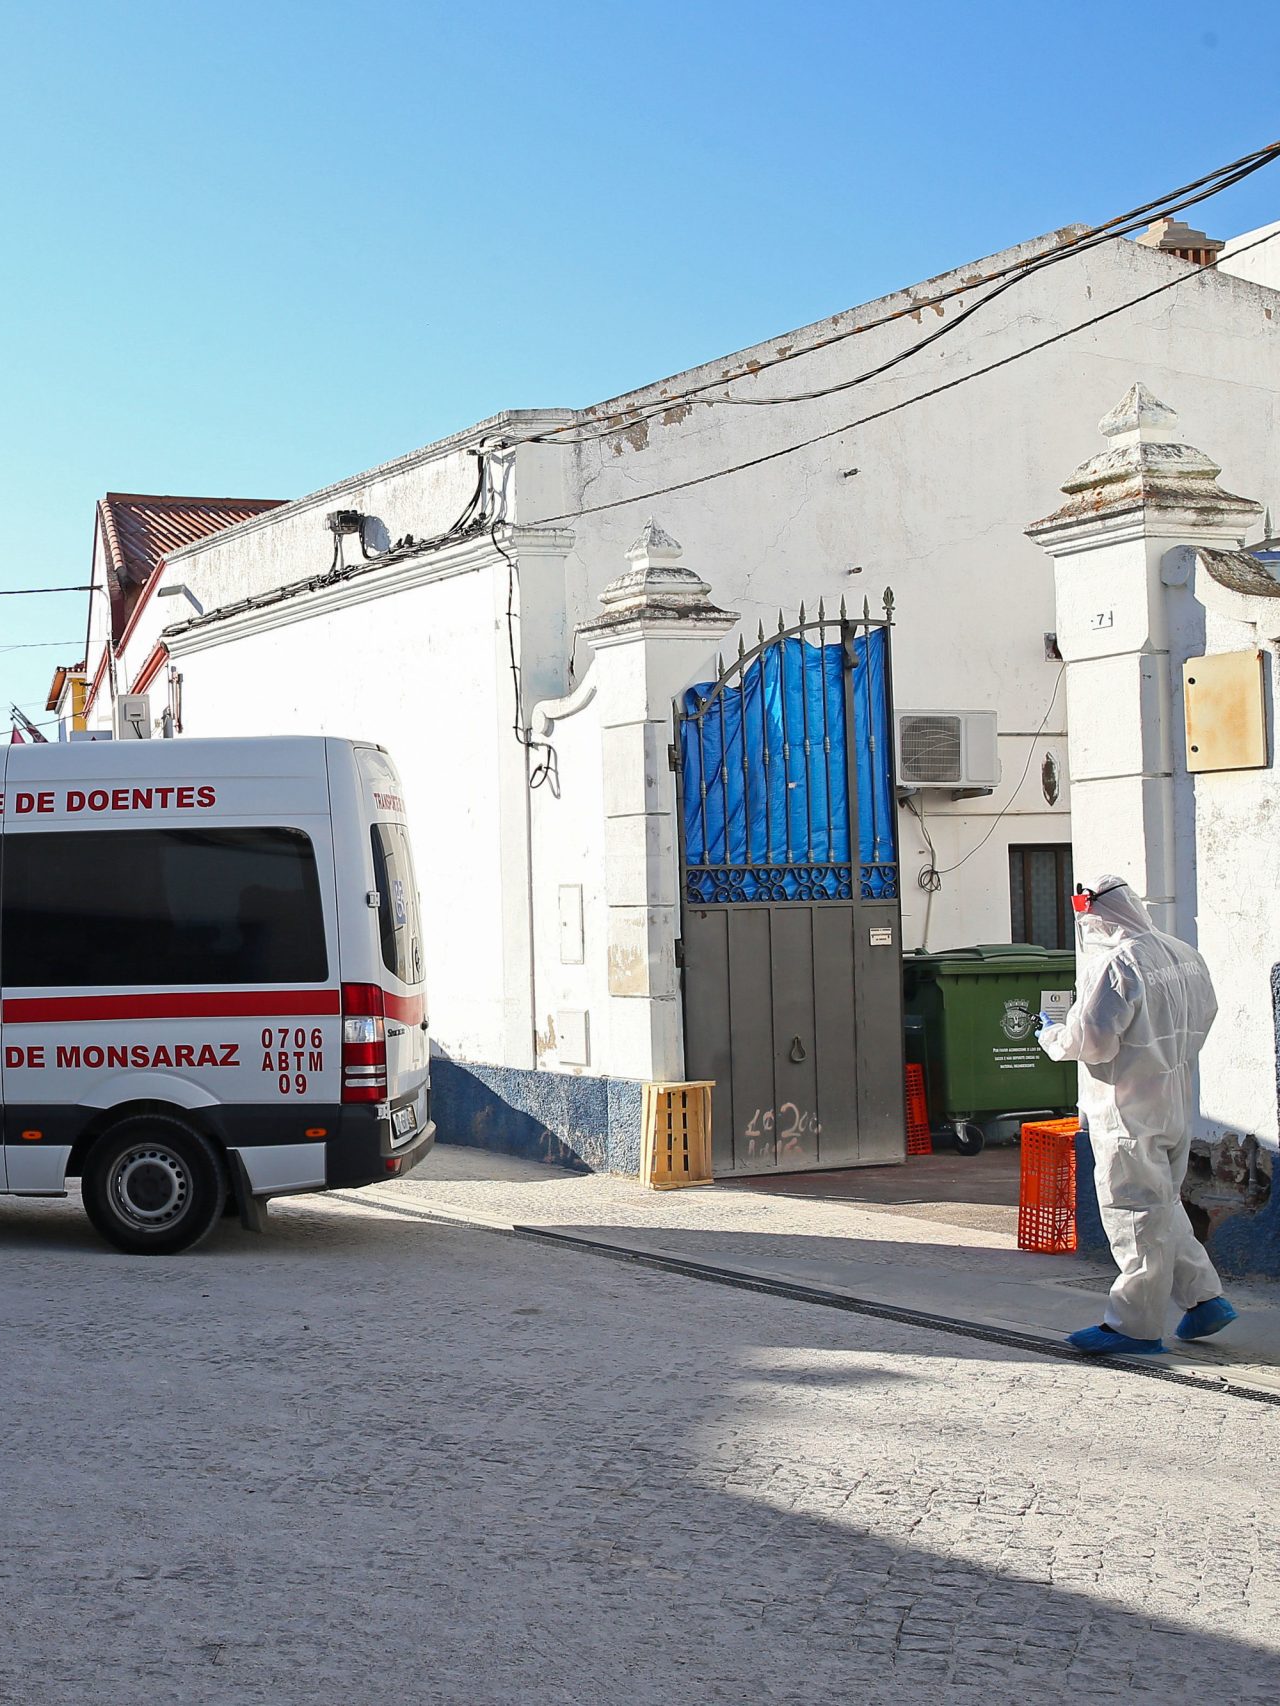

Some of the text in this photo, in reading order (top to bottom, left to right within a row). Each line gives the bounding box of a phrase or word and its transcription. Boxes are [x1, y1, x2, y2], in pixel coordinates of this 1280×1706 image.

[15, 792, 54, 814] DE
[66, 786, 216, 811] DOENTES
[262, 1028, 323, 1049] 0706
[5, 1046, 45, 1068] DE
[56, 1044, 240, 1068] MONSARAZ
[262, 1051, 323, 1072] ABTM
[278, 1073, 307, 1094] 09
